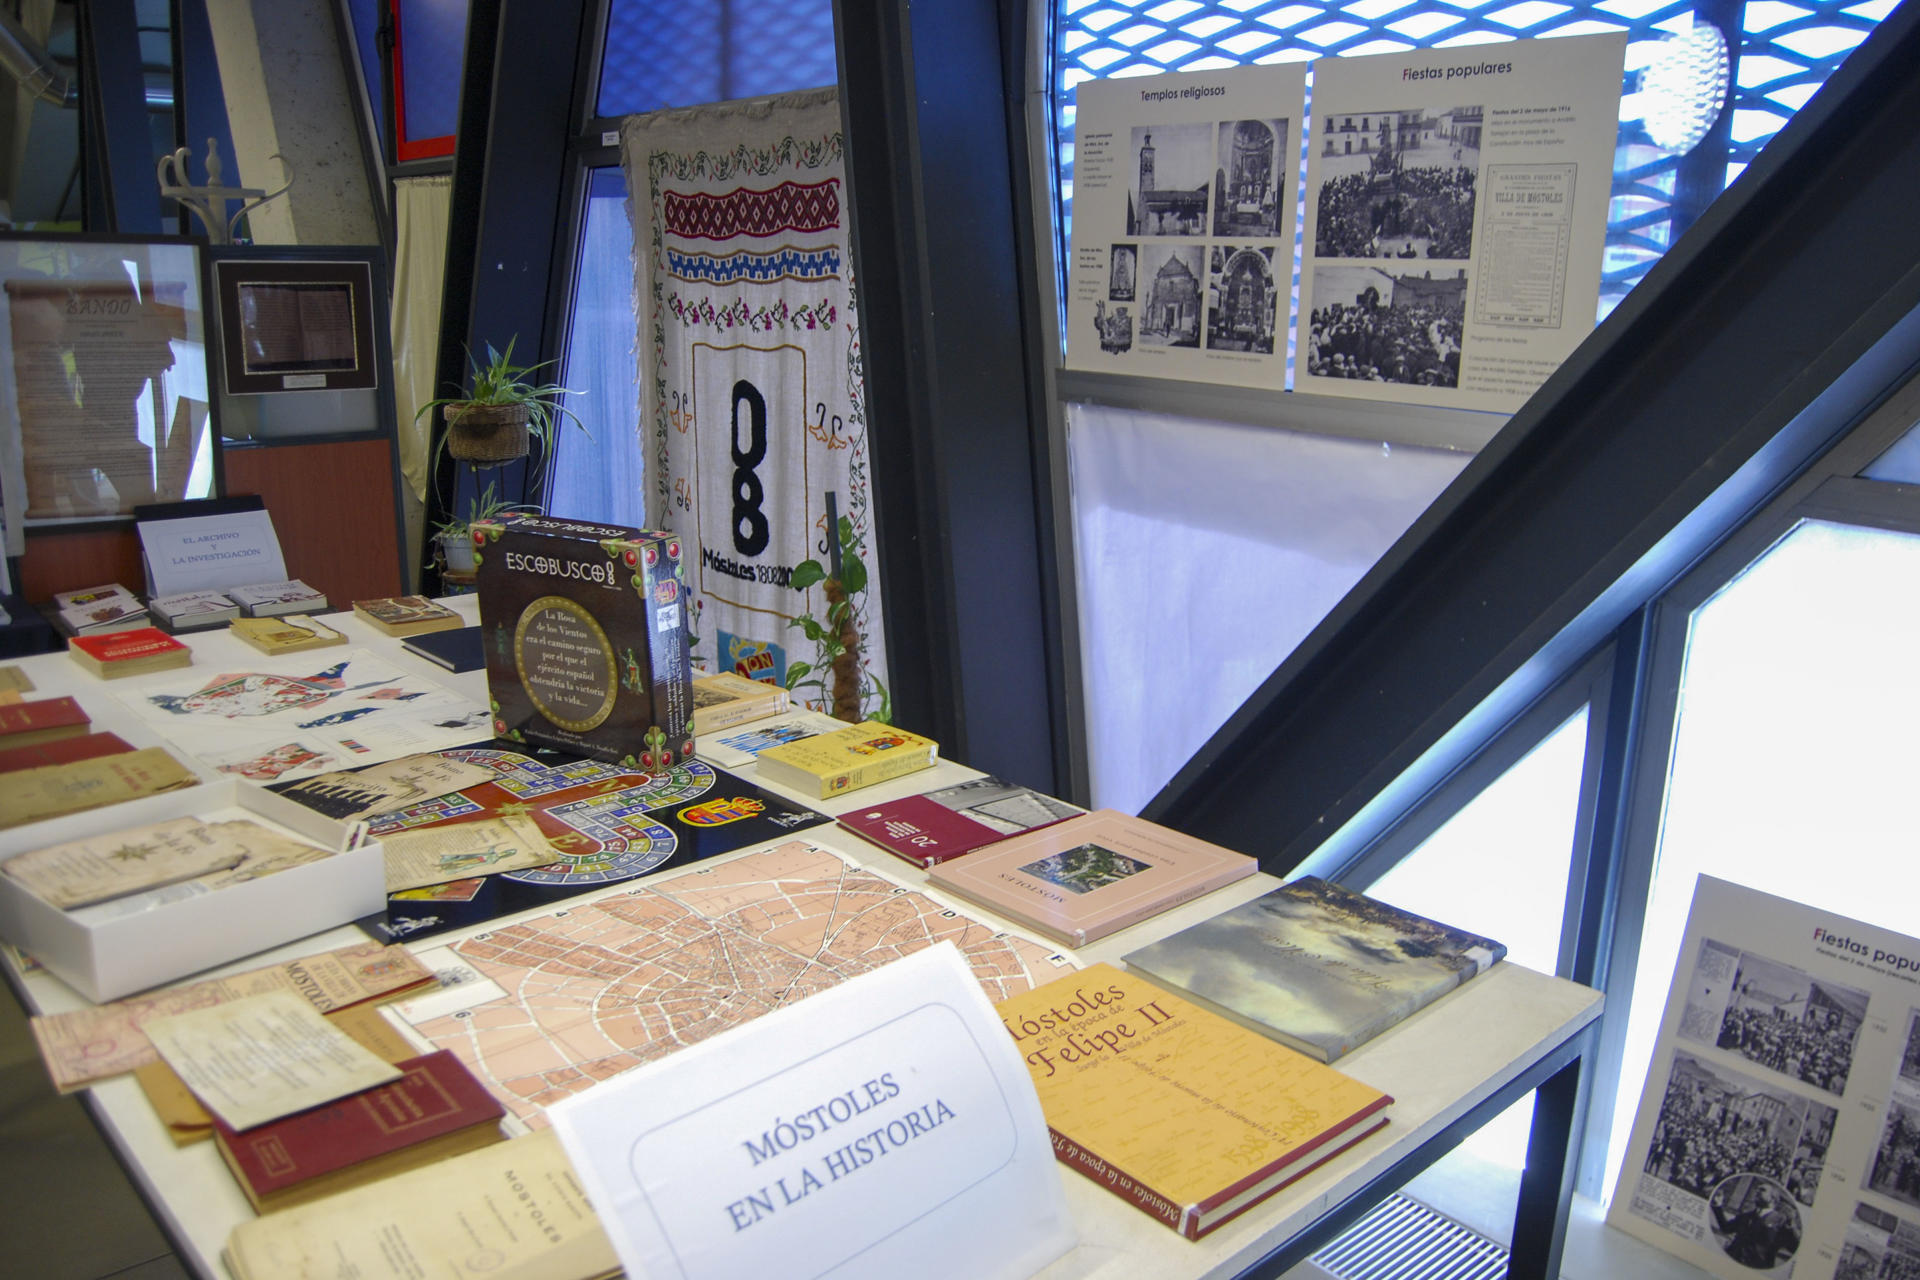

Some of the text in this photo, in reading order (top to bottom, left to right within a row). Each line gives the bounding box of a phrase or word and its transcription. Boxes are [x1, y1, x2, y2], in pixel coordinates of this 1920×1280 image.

[1402, 61, 1512, 81] Fiestas populares
[1141, 85, 1225, 102] Templos religiosos
[66, 300, 133, 316] BANDO
[183, 531, 240, 545] EL ARCHIVO
[211, 543, 217, 551] Y
[172, 547, 262, 566] LA INVESTIGACIÓN
[506, 551, 606, 583] ESCOBUSCO
[545, 609, 577, 623] La Rosa
[536, 622, 588, 639] de los Vientos
[526, 636, 602, 656] era el camino seguro
[542, 652, 588, 666] por el que el
[566, 670, 595, 681] español
[566, 680, 574, 690] la
[575, 685, 605, 697] victoria
[555, 691, 563, 702] la
[562, 801, 587, 811] 78
[625, 804, 644, 814] 10
[622, 828, 640, 838] 44
[651, 828, 664, 836] 8
[893, 887, 907, 896] C
[941, 909, 956, 919] D
[477, 932, 491, 941] 5
[1813, 927, 1920, 972] Fiestas popu
[1050, 953, 1067, 963] F
[455, 1011, 472, 1021] 6
[1035, 1003, 1126, 1047] en la época de
[1026, 1000, 1176, 1078] Felipe II
[742, 1072, 901, 1167] MÓSTOLES
[1066, 1145, 1079, 1159] de
[724, 1099, 957, 1233] EN LA HISTORIA
[1079, 1151, 1107, 1176] época
[1107, 1170, 1119, 1185] la
[1119, 1178, 1133, 1191] en
[1133, 1184, 1180, 1222] Móstoles
